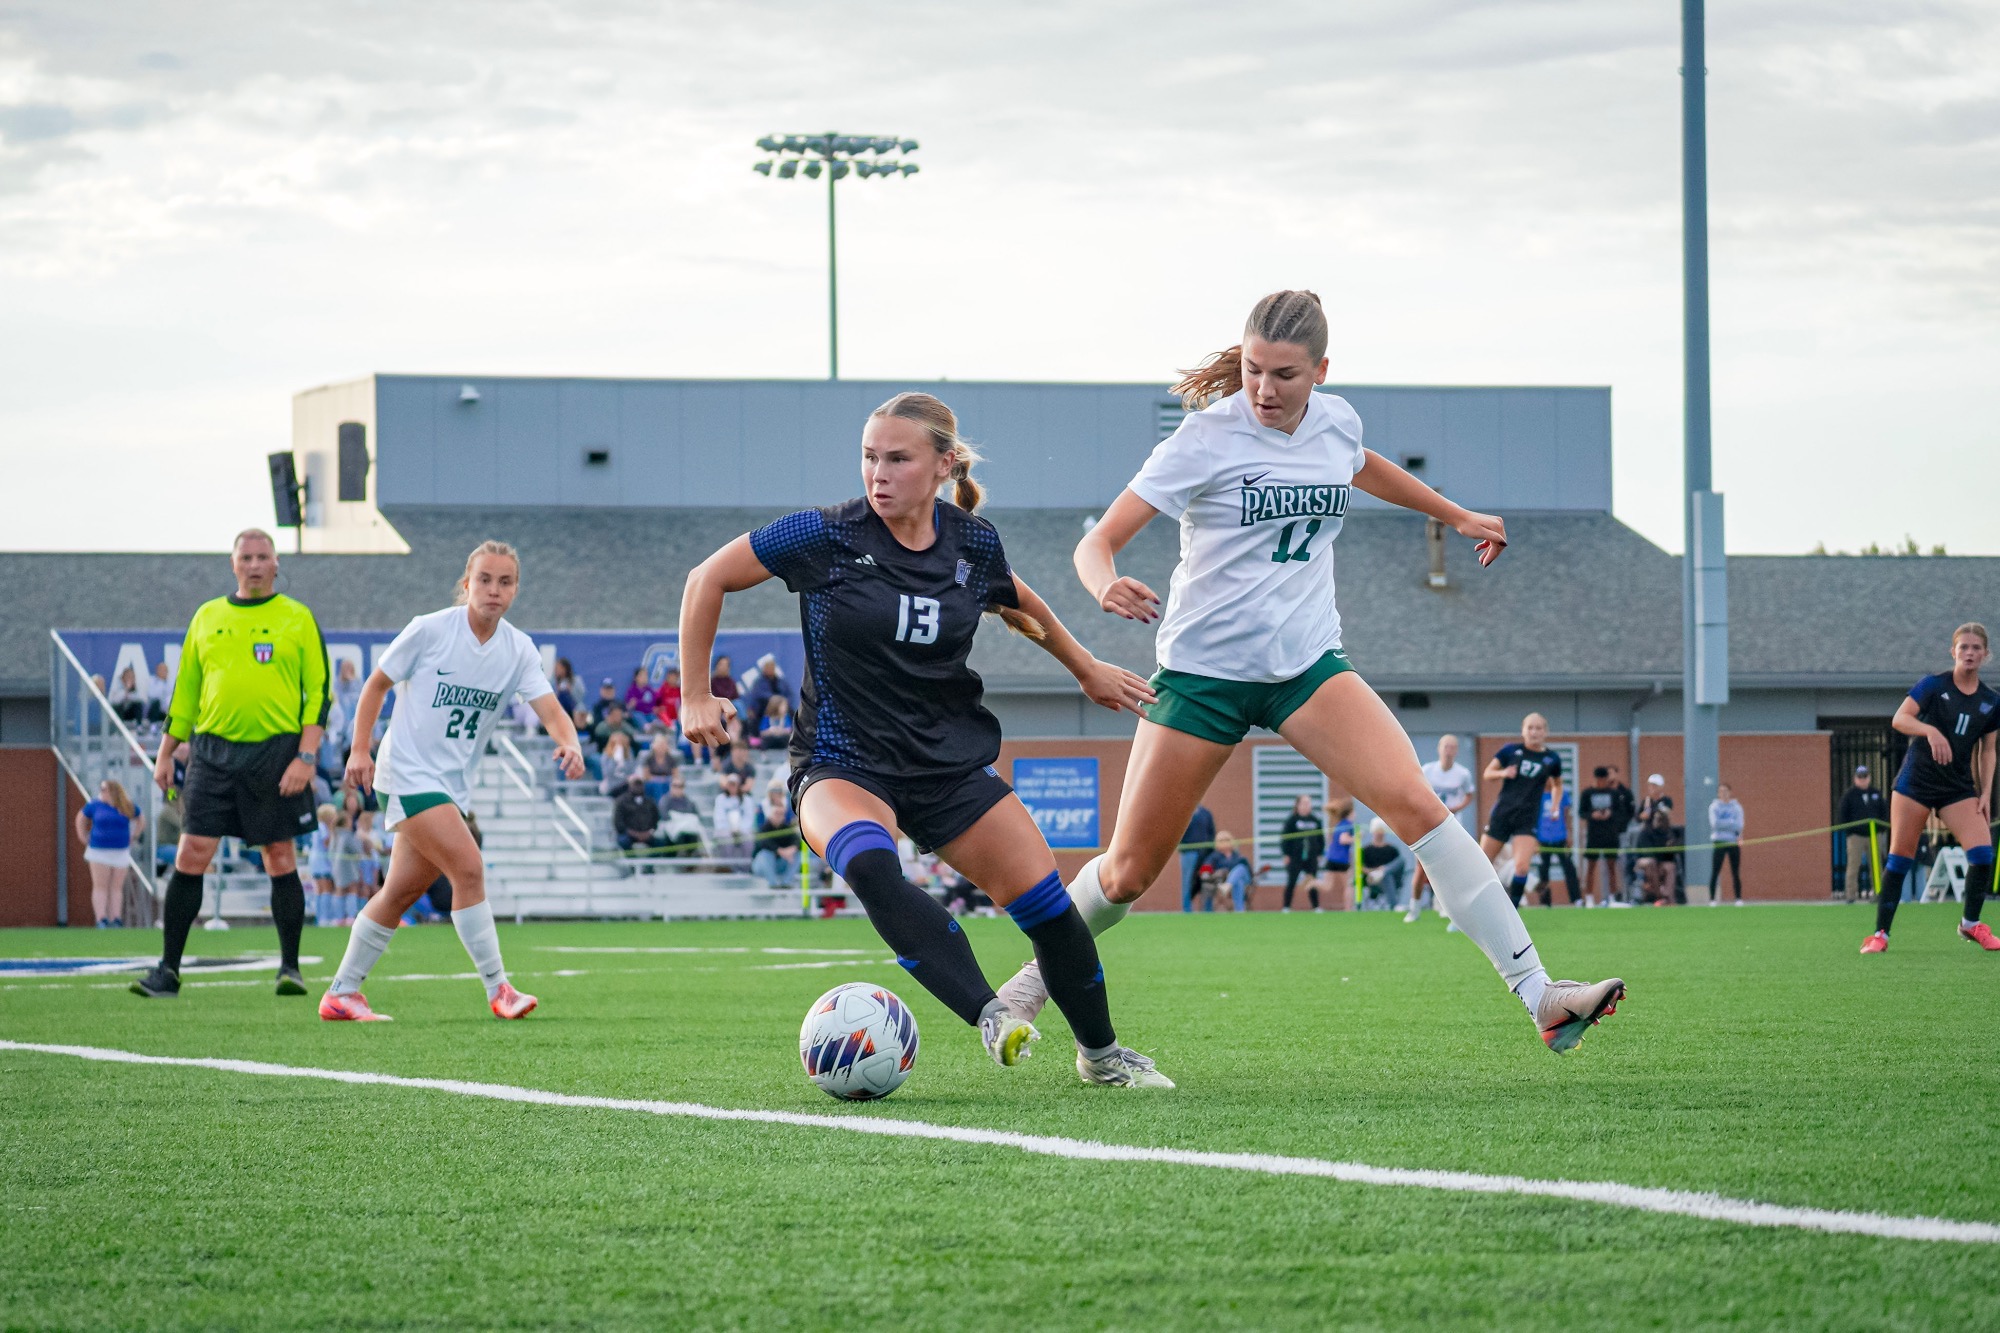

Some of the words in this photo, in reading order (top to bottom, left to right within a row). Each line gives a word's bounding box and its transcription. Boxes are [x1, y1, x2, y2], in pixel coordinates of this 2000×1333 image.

[895, 594, 940, 645] 13
[445, 708, 481, 739] 24
[1954, 713, 1970, 735] 11
[1520, 760, 1542, 778] 27
[1024, 803, 1095, 830] erger
